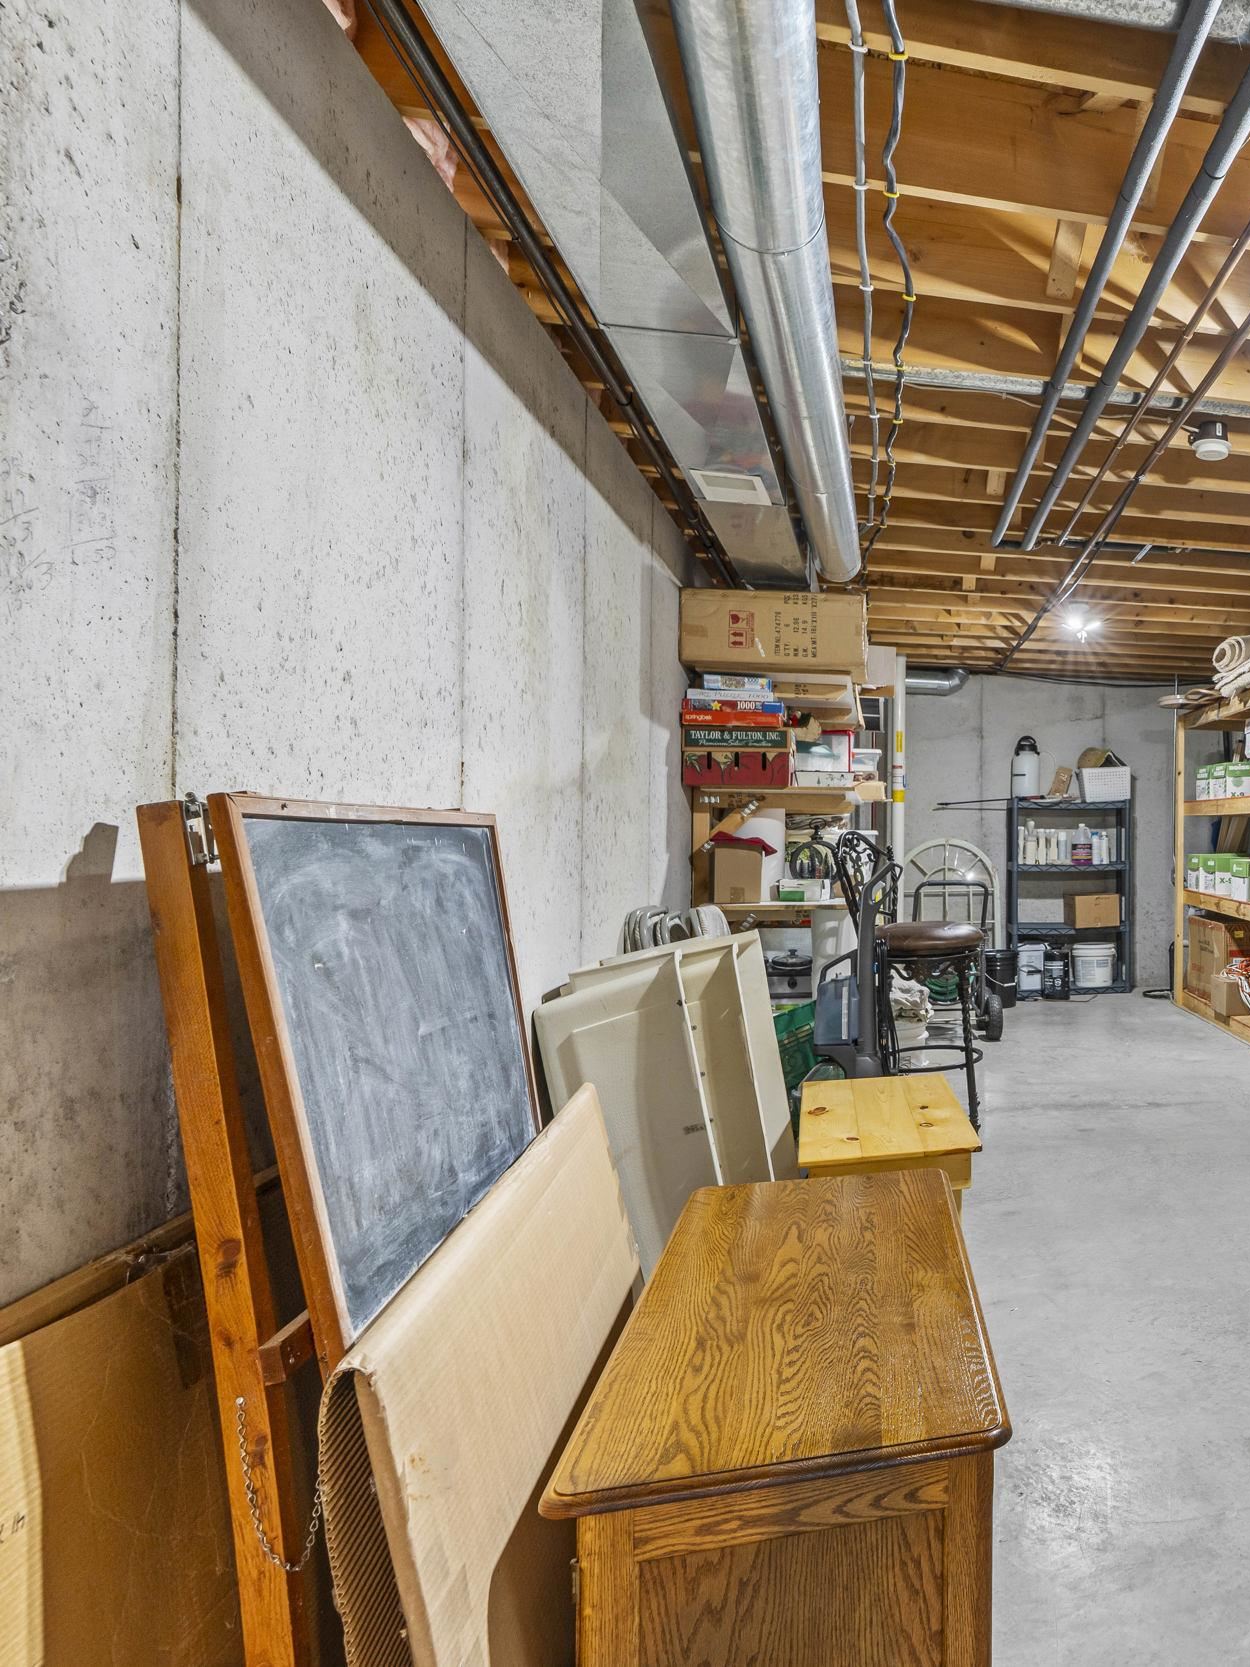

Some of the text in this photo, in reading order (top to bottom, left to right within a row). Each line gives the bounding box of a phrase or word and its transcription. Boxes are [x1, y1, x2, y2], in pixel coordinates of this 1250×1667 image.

[737, 701, 755, 710] 1000
[690, 730, 721, 739] TAYLOR
[723, 731, 731, 739] &
[766, 732, 781, 740] INC.
